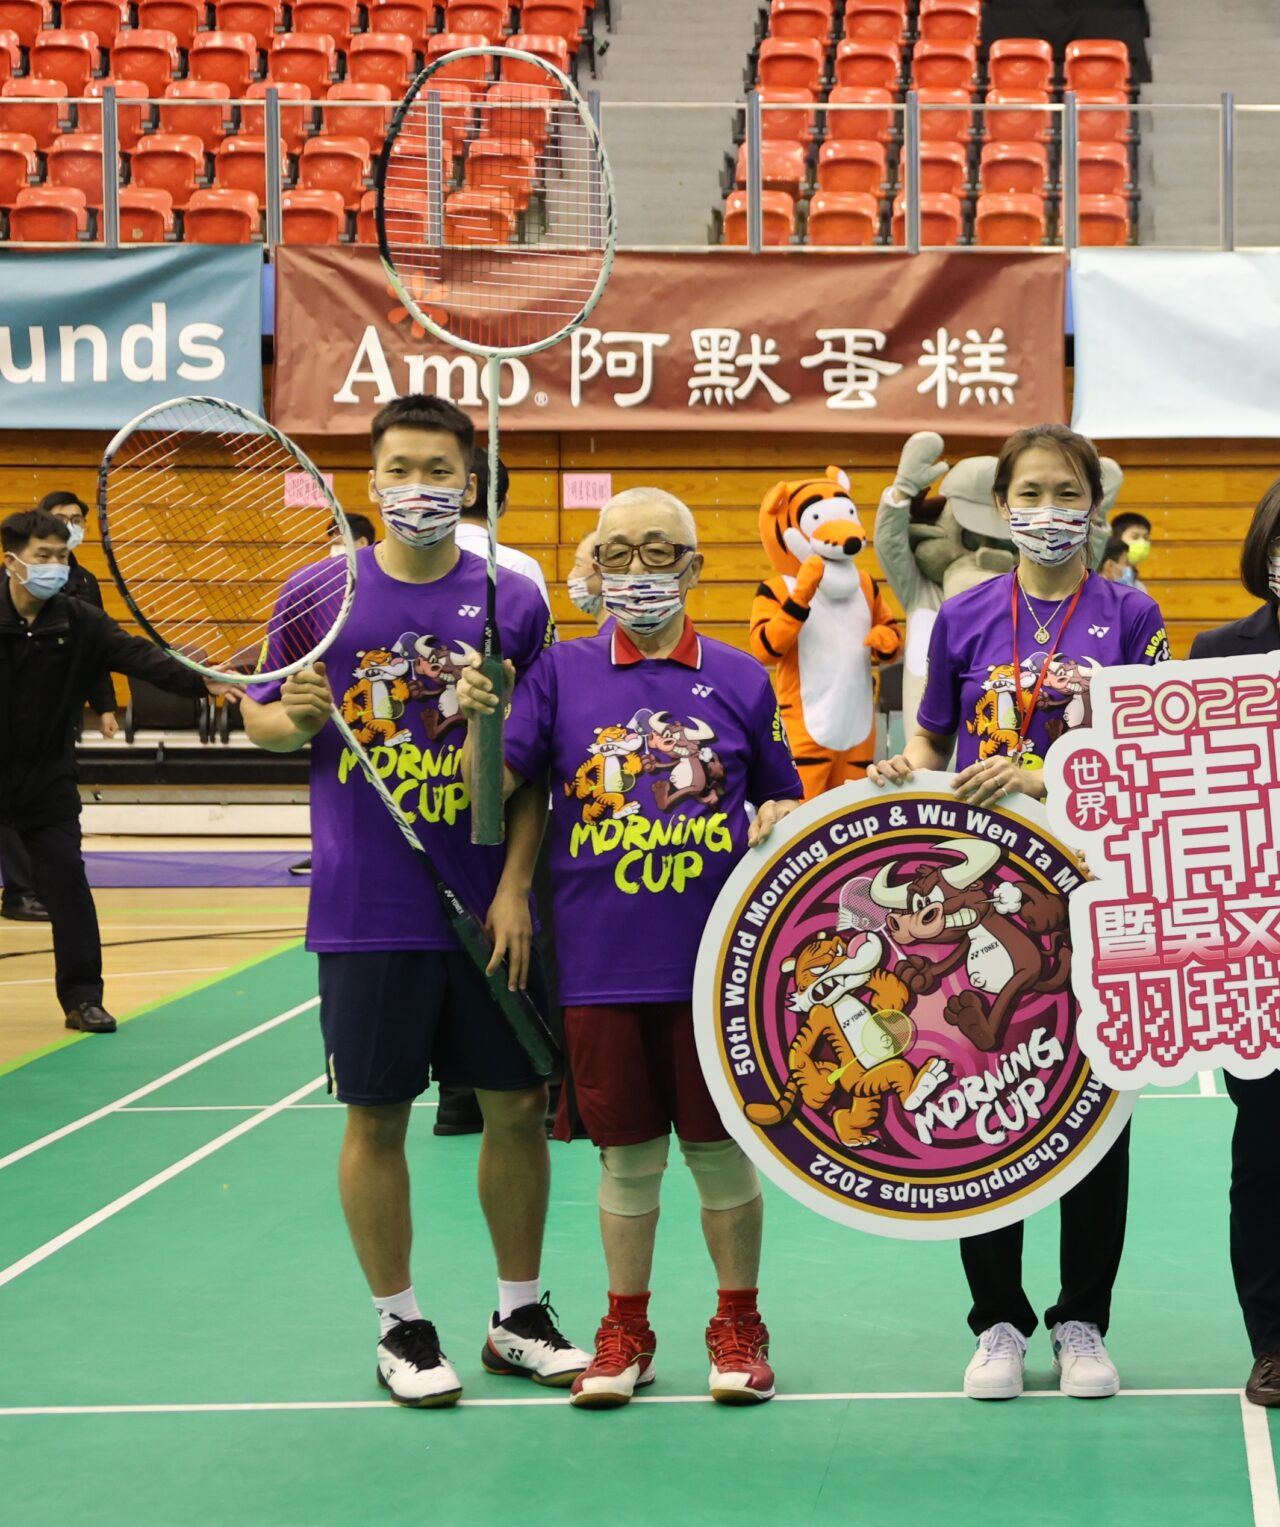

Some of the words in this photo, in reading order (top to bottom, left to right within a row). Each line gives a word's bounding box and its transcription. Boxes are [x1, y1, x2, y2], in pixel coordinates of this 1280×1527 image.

[0, 302, 226, 383] unds
[570, 326, 1019, 409] 阿默蛋糕
[391, 778, 472, 826] CUP
[1070, 755, 1109, 827] 世界
[829, 814, 880, 845] Cup
[888, 805, 908, 826] &
[917, 803, 957, 827] Wu
[966, 810, 1018, 848] Wen
[614, 849, 703, 895] CUP
[1024, 837, 1053, 871] Ta
[744, 839, 829, 927] Morning
[724, 930, 758, 1007] World
[979, 941, 1000, 955] YONEX
[850, 1008, 867, 1023] YONEX
[726, 1016, 756, 1076] 50th
[975, 1077, 1046, 1145] CUP
[809, 1153, 874, 1199] 2022
[879, 1132, 1070, 1209] Championships
